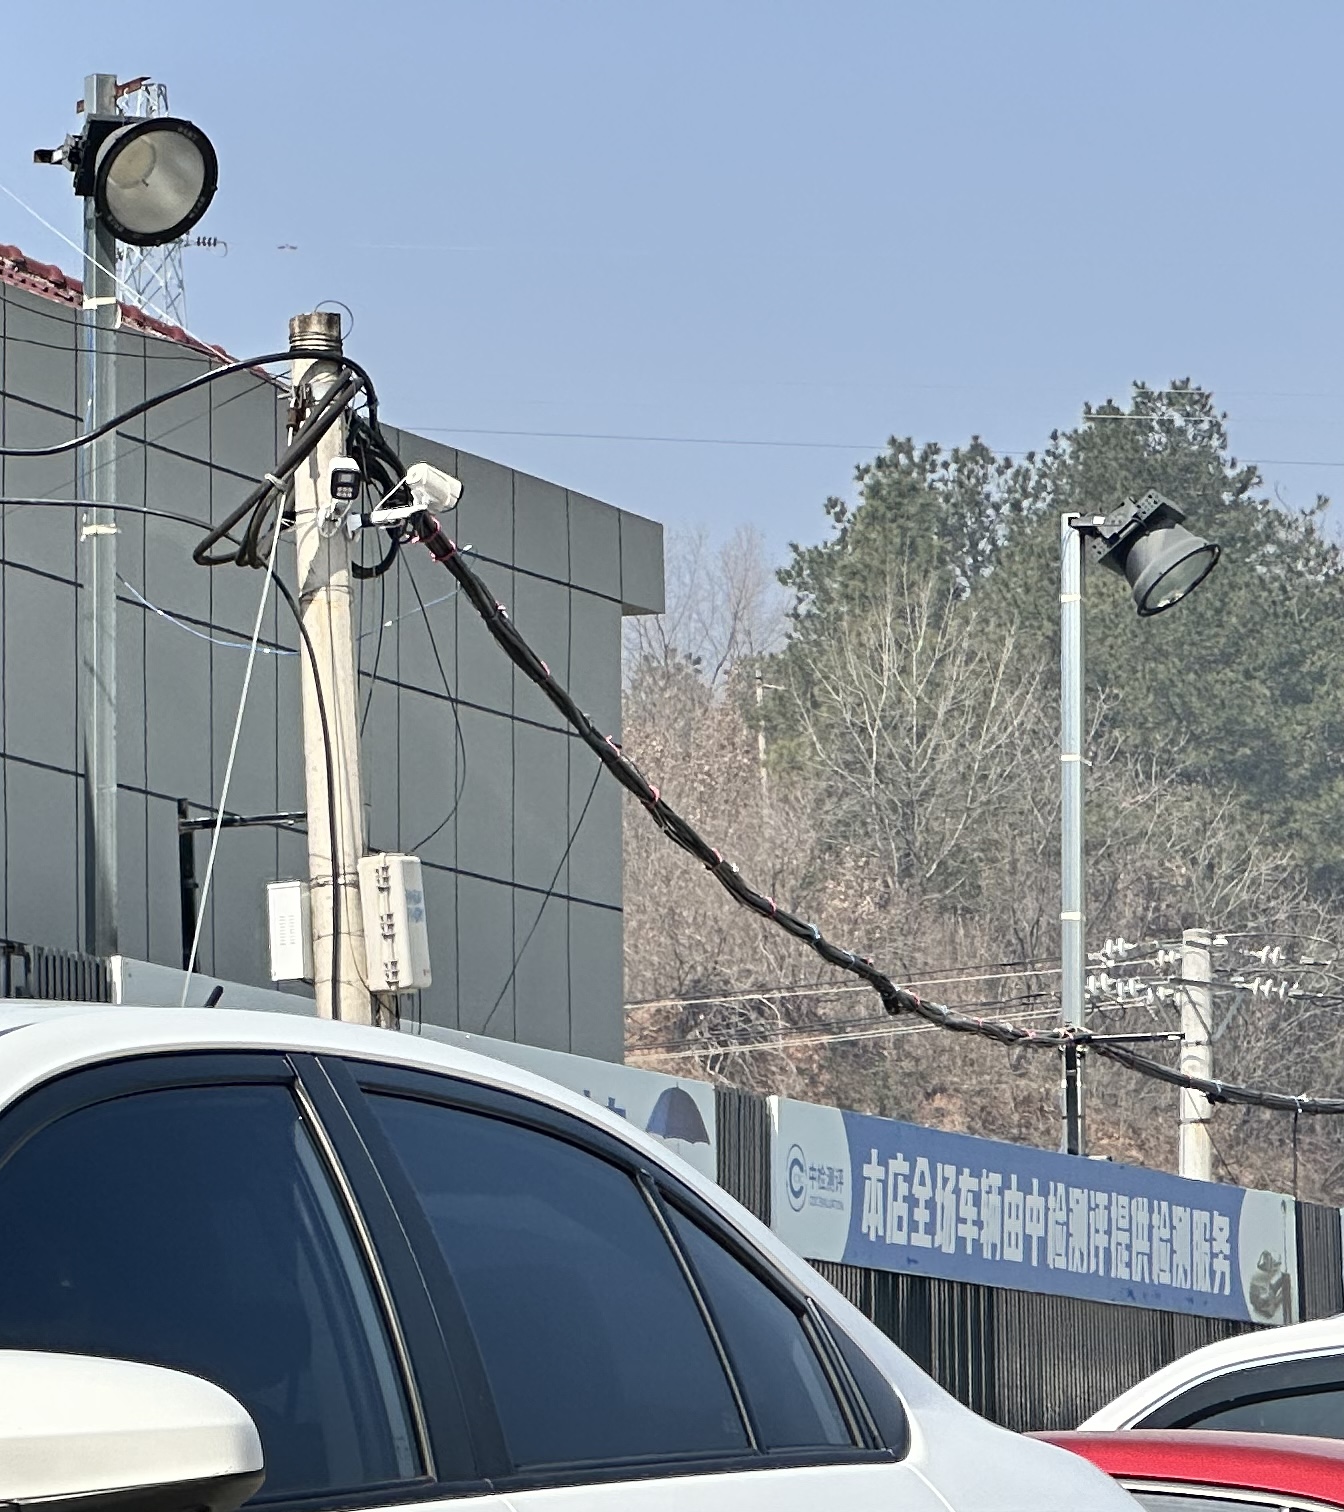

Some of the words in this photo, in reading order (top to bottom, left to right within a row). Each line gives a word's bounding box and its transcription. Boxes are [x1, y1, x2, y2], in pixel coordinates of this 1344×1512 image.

[861, 1148, 1231, 1296] 本店全场车辆由中检测评提供检测服务
